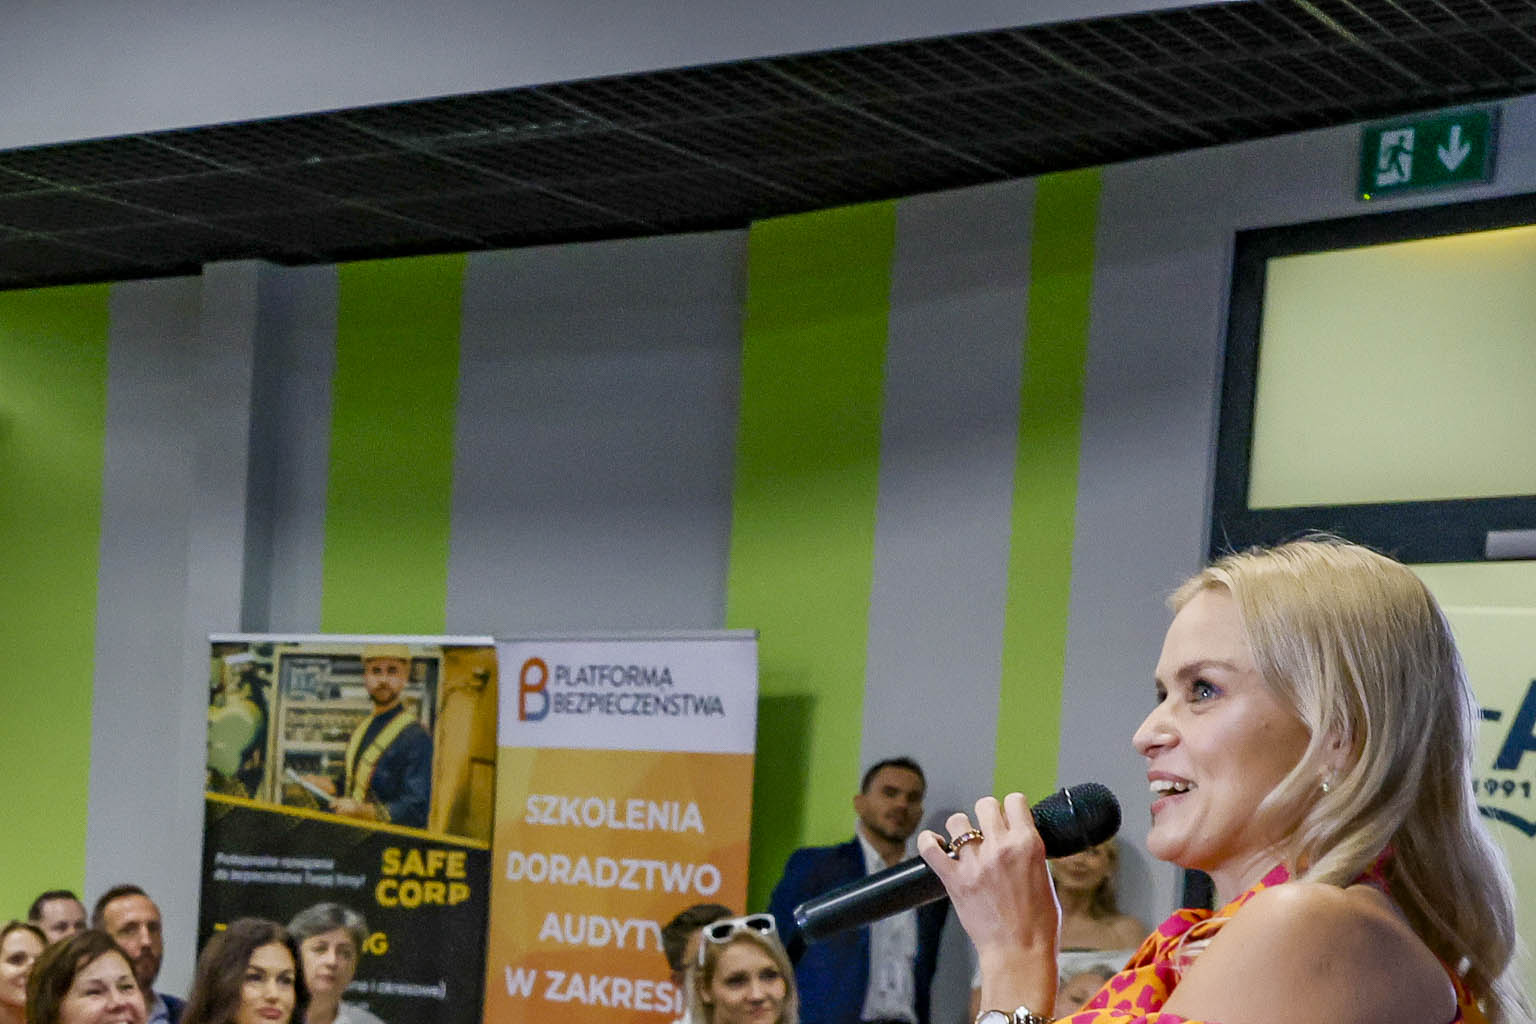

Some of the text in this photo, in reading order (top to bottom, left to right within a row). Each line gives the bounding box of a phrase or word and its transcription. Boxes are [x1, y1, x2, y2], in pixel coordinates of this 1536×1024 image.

[555, 664, 673, 688] PLATFORMA
[525, 793, 704, 834] SZKOLENIA
[381, 847, 467, 879] SAFE
[506, 850, 722, 896] DORADZTWO
[375, 878, 470, 908] CORP
[505, 965, 537, 998] W
